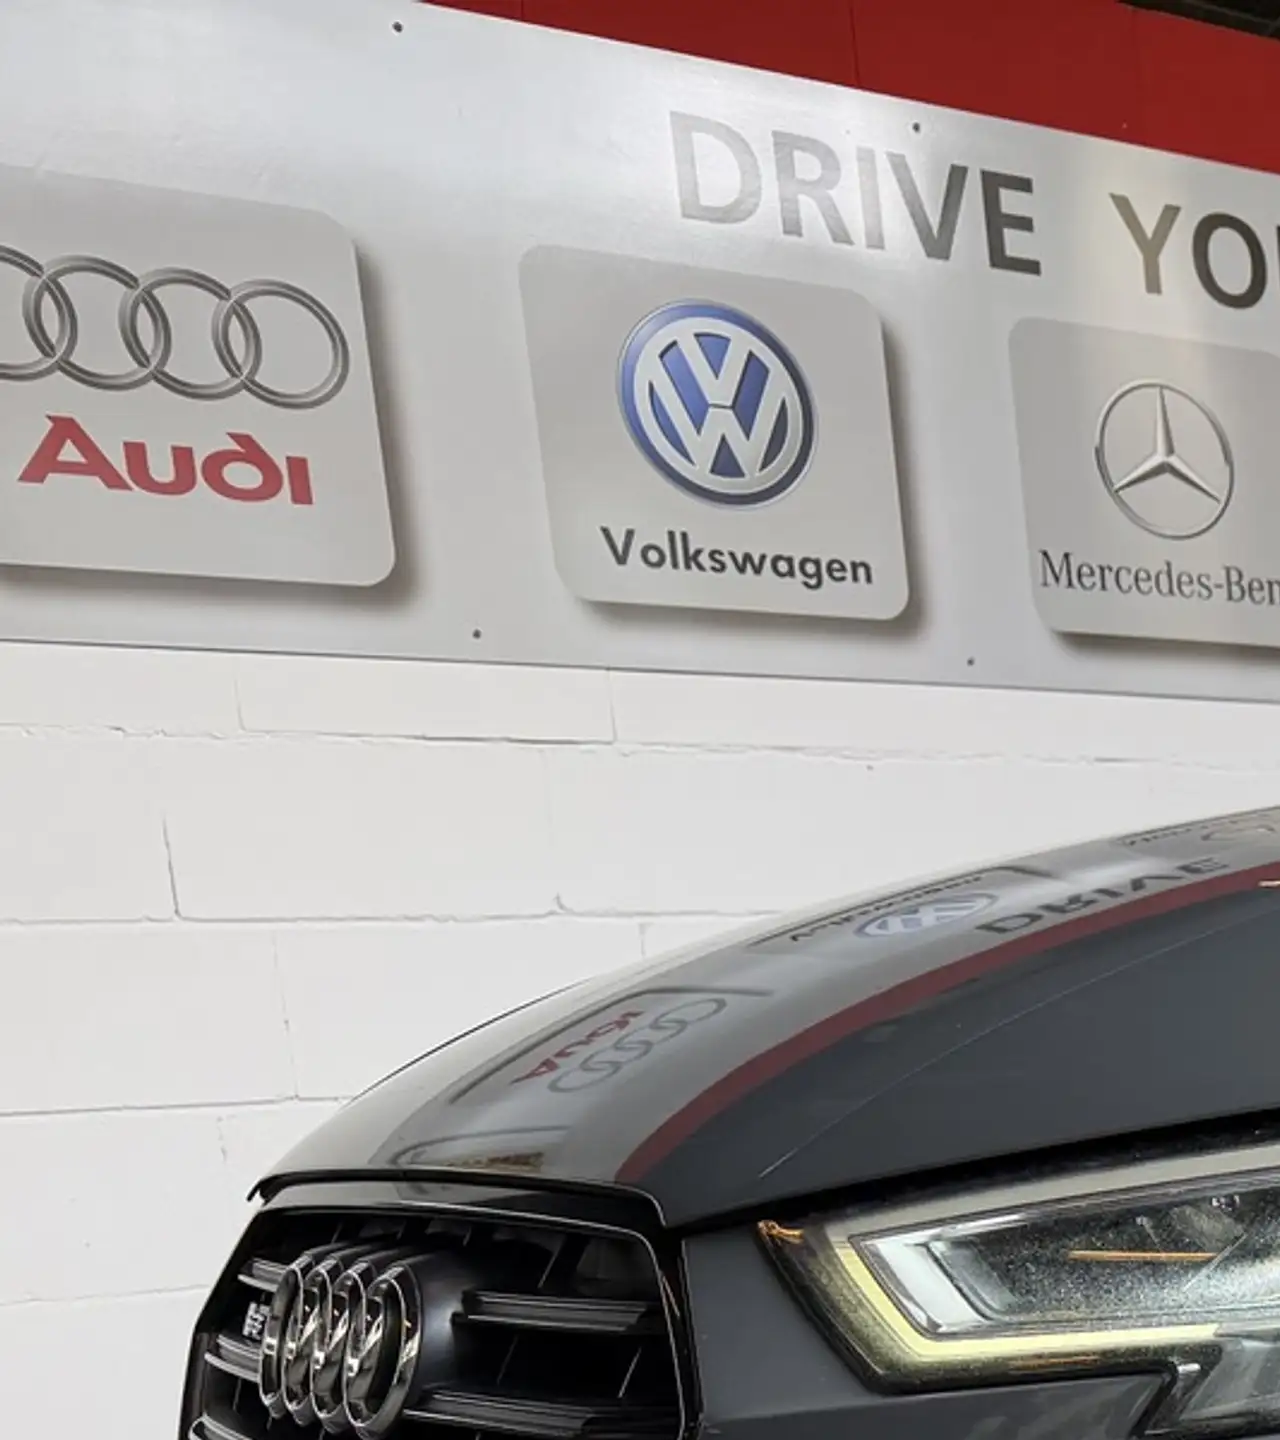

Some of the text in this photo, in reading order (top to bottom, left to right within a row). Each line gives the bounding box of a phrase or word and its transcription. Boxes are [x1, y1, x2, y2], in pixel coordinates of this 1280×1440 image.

[670, 111, 1042, 276] DRIVE
[17, 414, 314, 506] Audi
[600, 525, 874, 590] Volkswagen
